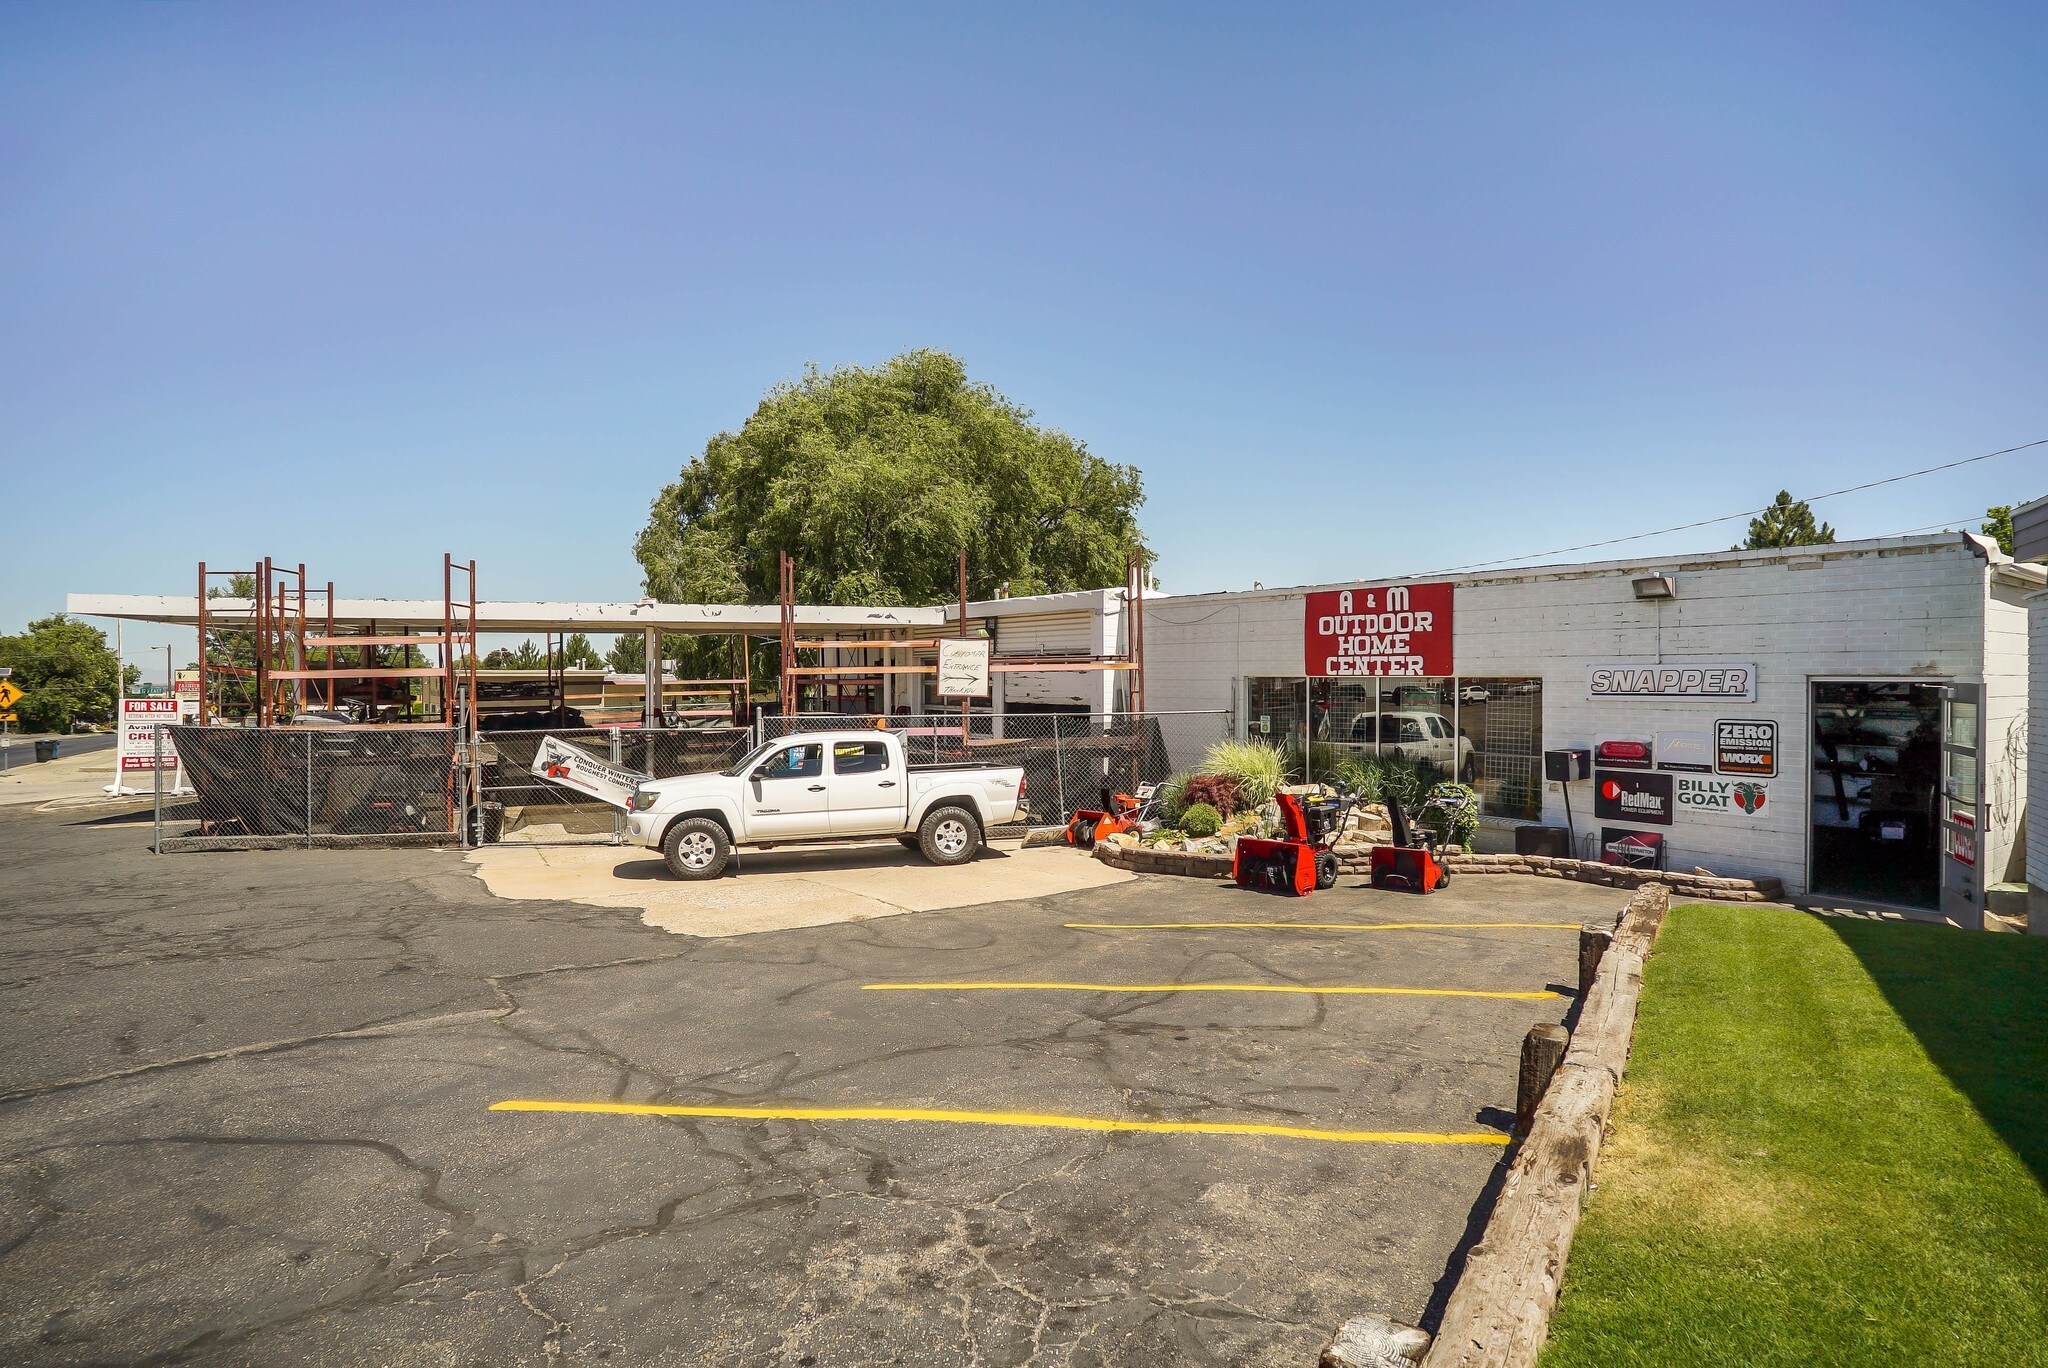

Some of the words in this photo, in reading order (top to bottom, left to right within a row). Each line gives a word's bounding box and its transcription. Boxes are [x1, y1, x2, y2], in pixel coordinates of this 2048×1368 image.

[1340, 590, 1352, 614] A
[1367, 593, 1376, 608] &
[1386, 586, 1409, 612] M
[1319, 611, 1433, 635] OUTDOOR
[1338, 633, 1410, 655] HOME
[1326, 655, 1424, 675] CENTER
[1591, 669, 1747, 693] SNAPPER
[128, 702, 147, 711] FOR
[149, 702, 174, 711] SALE
[1720, 725, 1772, 740] ZERO
[1720, 738, 1772, 747] EMISSION
[1723, 752, 1764, 764] WORX
[574, 756, 606, 774] CONQUER
[608, 770, 640, 787] WINTER'S
[576, 763, 607, 780] ROUGHEST
[608, 776, 637, 792] CONDITIO
[1678, 779, 1730, 793] BILLY
[1621, 790, 1661, 809] RedMax
[1678, 792, 1730, 807] GOAT
[1630, 847, 1654, 855] STRATTON
